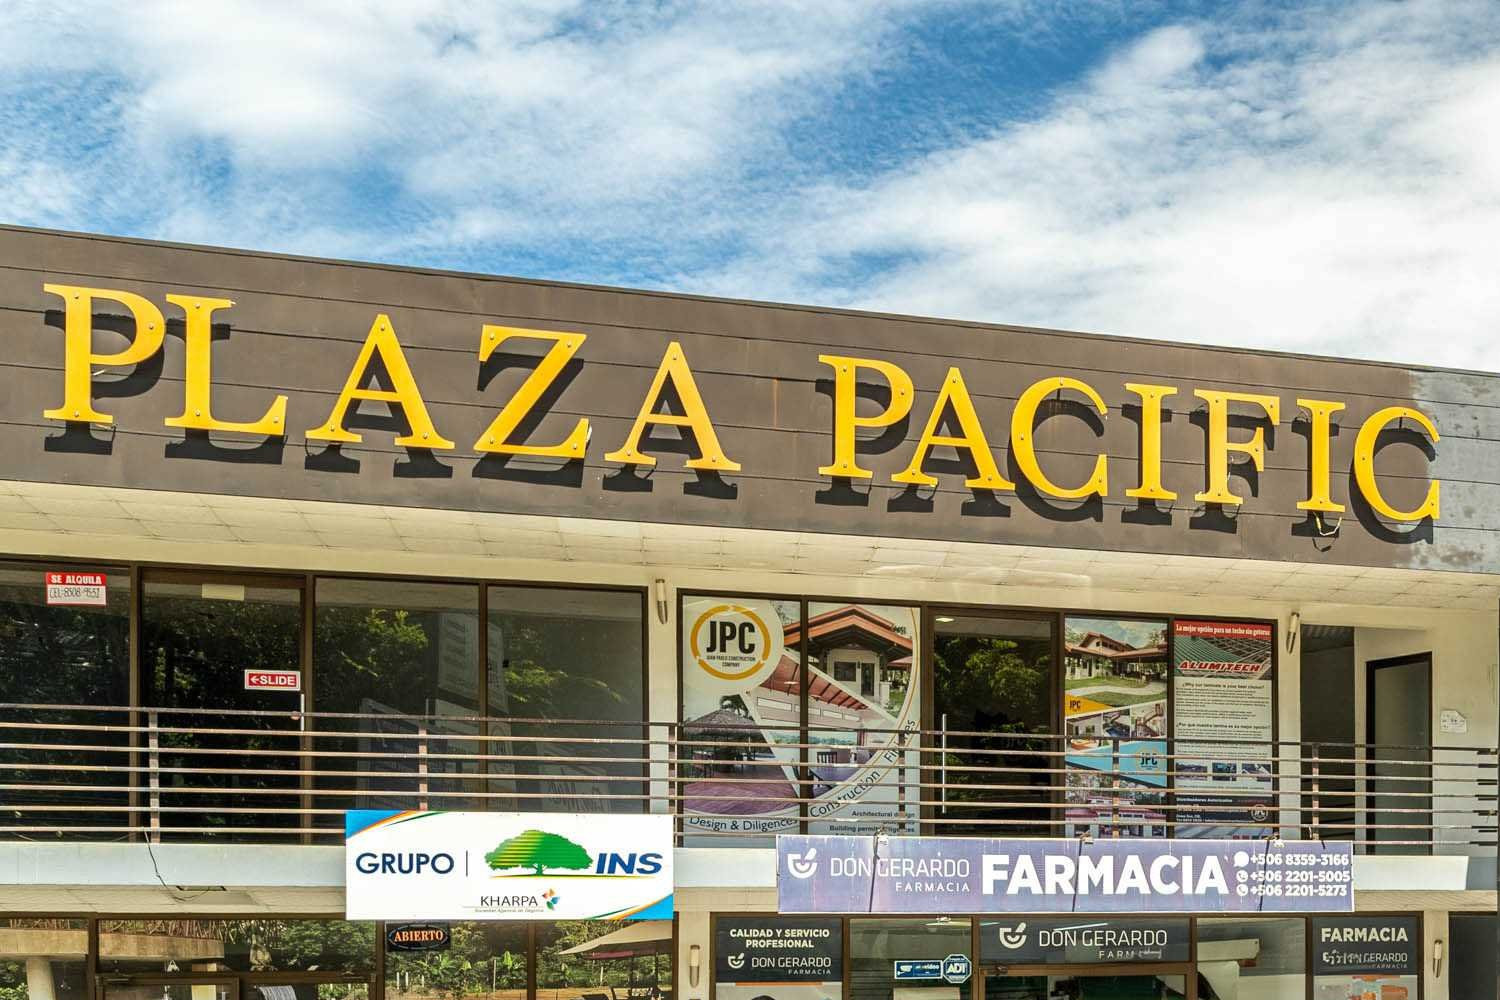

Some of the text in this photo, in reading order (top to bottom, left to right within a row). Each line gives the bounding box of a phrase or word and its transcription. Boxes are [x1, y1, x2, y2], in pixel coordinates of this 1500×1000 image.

[43, 283, 741, 472] PLAZA
[818, 354, 1440, 521] PACIFIC
[51, 574, 102, 585] SE ALQUILA
[706, 620, 756, 655] JPC
[1180, 661, 1261, 672] ALUMITECH
[259, 674, 295, 686] SLIDE
[1069, 699, 1081, 710] JPC
[1140, 752, 1158, 766] JPC
[809, 768, 881, 818] Construction
[851, 810, 892, 818] Architectural
[689, 813, 799, 831] Design & Diligences
[829, 824, 855, 832] Building
[355, 852, 663, 875] GRUPO INS
[1250, 854, 1349, 866] +506 8359-3166
[830, 857, 970, 877] DON GERARDO
[982, 854, 1229, 895] FARMACIA
[1250, 870, 1350, 883] +506 2201-5005
[896, 882, 970, 892] FARMACIA
[1250, 885, 1347, 897] +506 2201-5273
[480, 894, 538, 907] KHARPA
[393, 929, 444, 944] ABIERTO
[730, 929, 830, 937] CALIDAD Y SERVICIO
[1039, 930, 1168, 946] DON GERARDO
[1321, 927, 1409, 942] FARMACIA
[746, 940, 814, 948] PROFESIONAL
[751, 957, 831, 967] DON GERARDO
[1363, 952, 1408, 963] GERARDO
[946, 963, 966, 973] ADT
